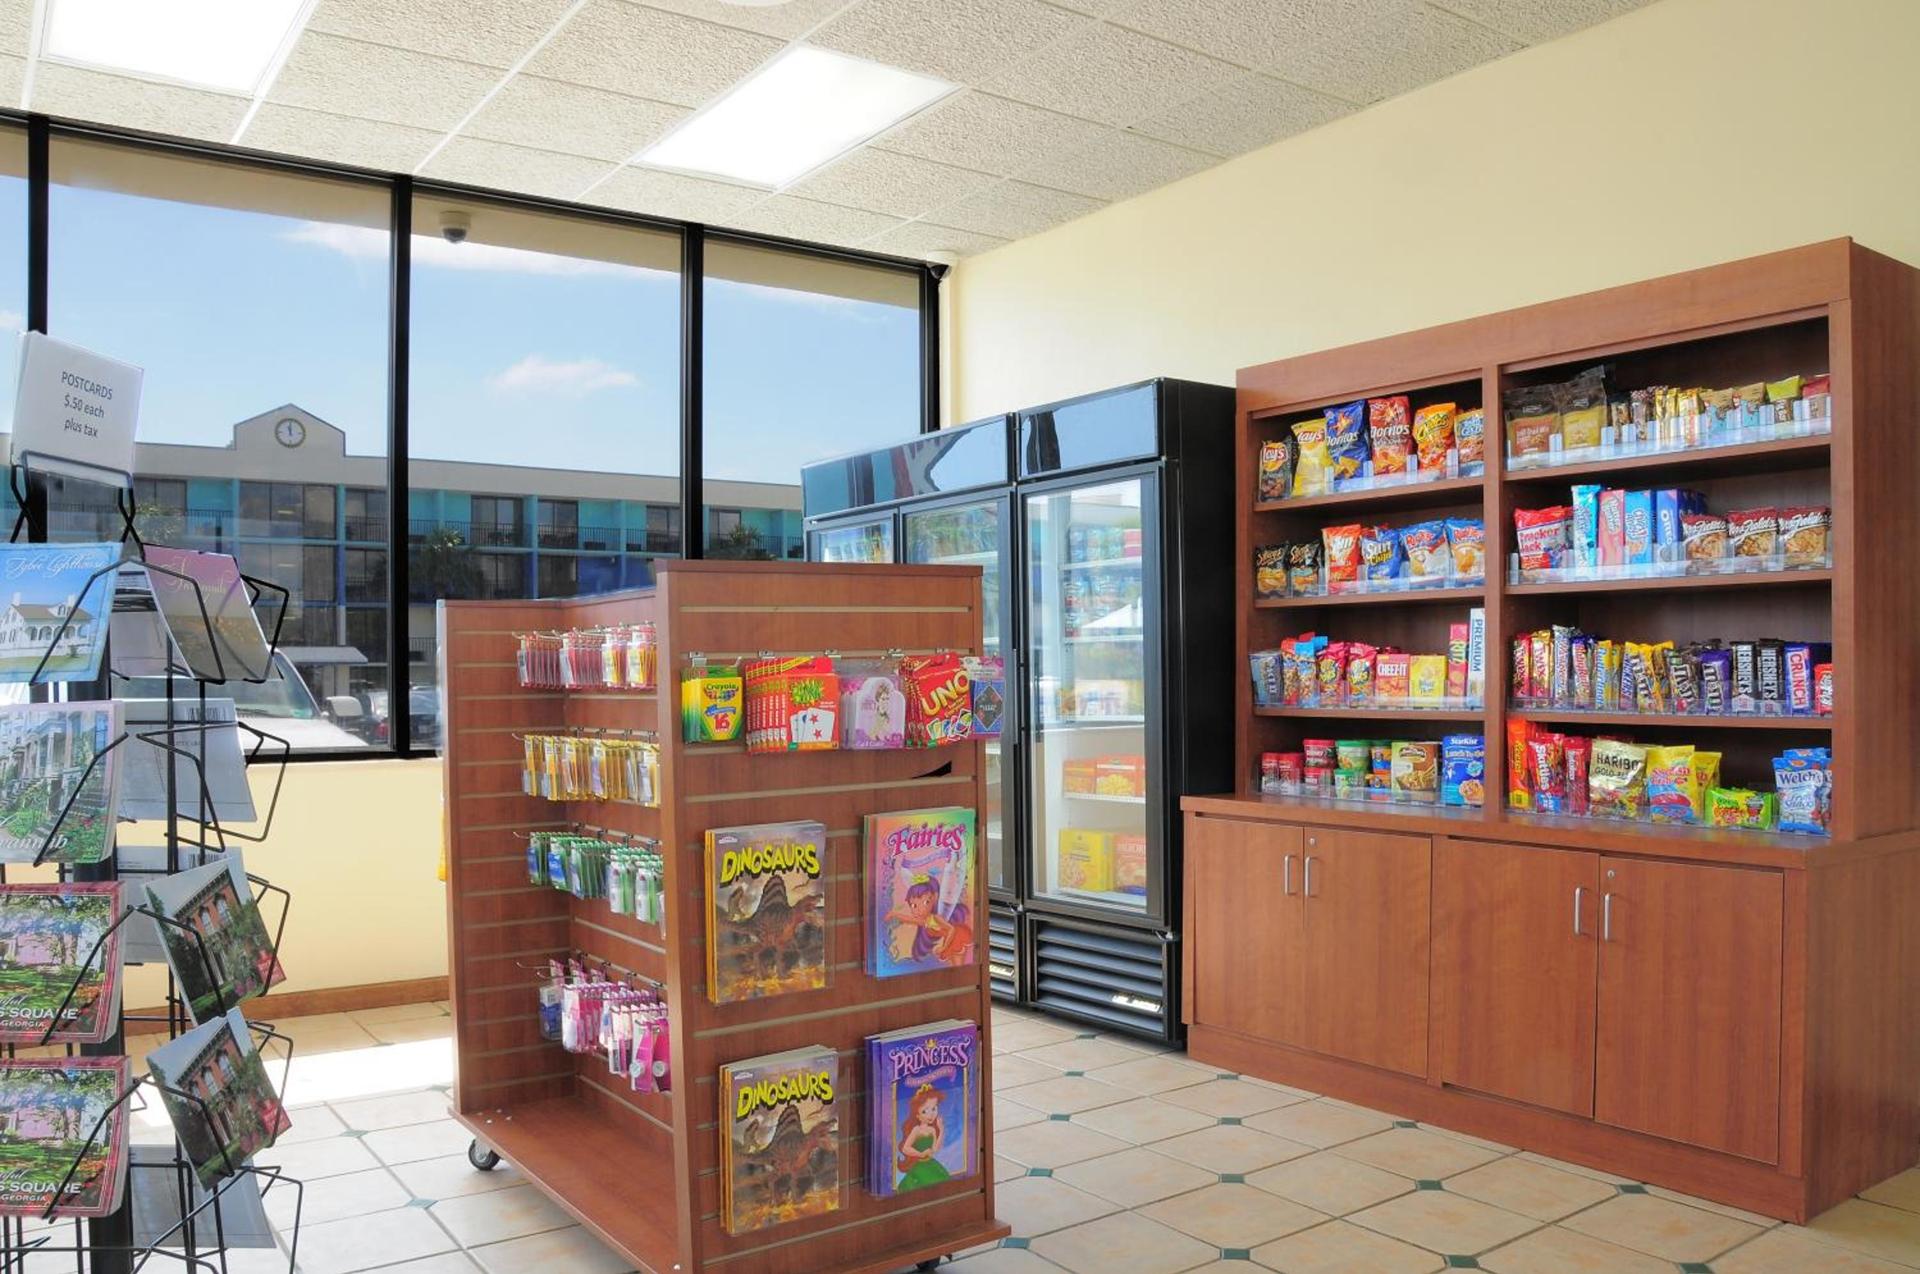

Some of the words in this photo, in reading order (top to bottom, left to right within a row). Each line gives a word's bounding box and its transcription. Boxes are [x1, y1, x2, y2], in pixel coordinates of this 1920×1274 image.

[61, 371, 113, 400] POSTCARDS
[64, 394, 82, 411] $.50
[84, 405, 104, 418] each
[64, 418, 82, 433] plus
[84, 424, 98, 438] tax
[1370, 424, 1410, 438] Doritos
[1472, 618, 1484, 672] PREMIUM
[1377, 663, 1408, 677] CHEEZ-IT
[1737, 644, 1753, 695] HERSHEY'S
[1761, 649, 1778, 701] HERSHEY'S
[1789, 653, 1806, 706] CRUNCH
[706, 682, 737, 692] Crayola
[922, 669, 971, 718] UNO
[714, 712, 730, 731] 16
[1450, 736, 1478, 745] StarKist
[1535, 743, 1550, 791] Skittles
[1596, 753, 1640, 771] HARIBO
[1779, 770, 1821, 786] Welch's
[888, 822, 966, 856] Fairies
[720, 843, 821, 885] DINOSAURS
[2, 1019, 46, 1028] GEORGIA
[9, 1007, 79, 1020] SQUARE
[889, 1036, 971, 1081] PRINCESS
[736, 1071, 834, 1119] DINOSAURS
[1, 1193, 47, 1202] GEORGIA
[9, 1181, 83, 1195] SQUARE
